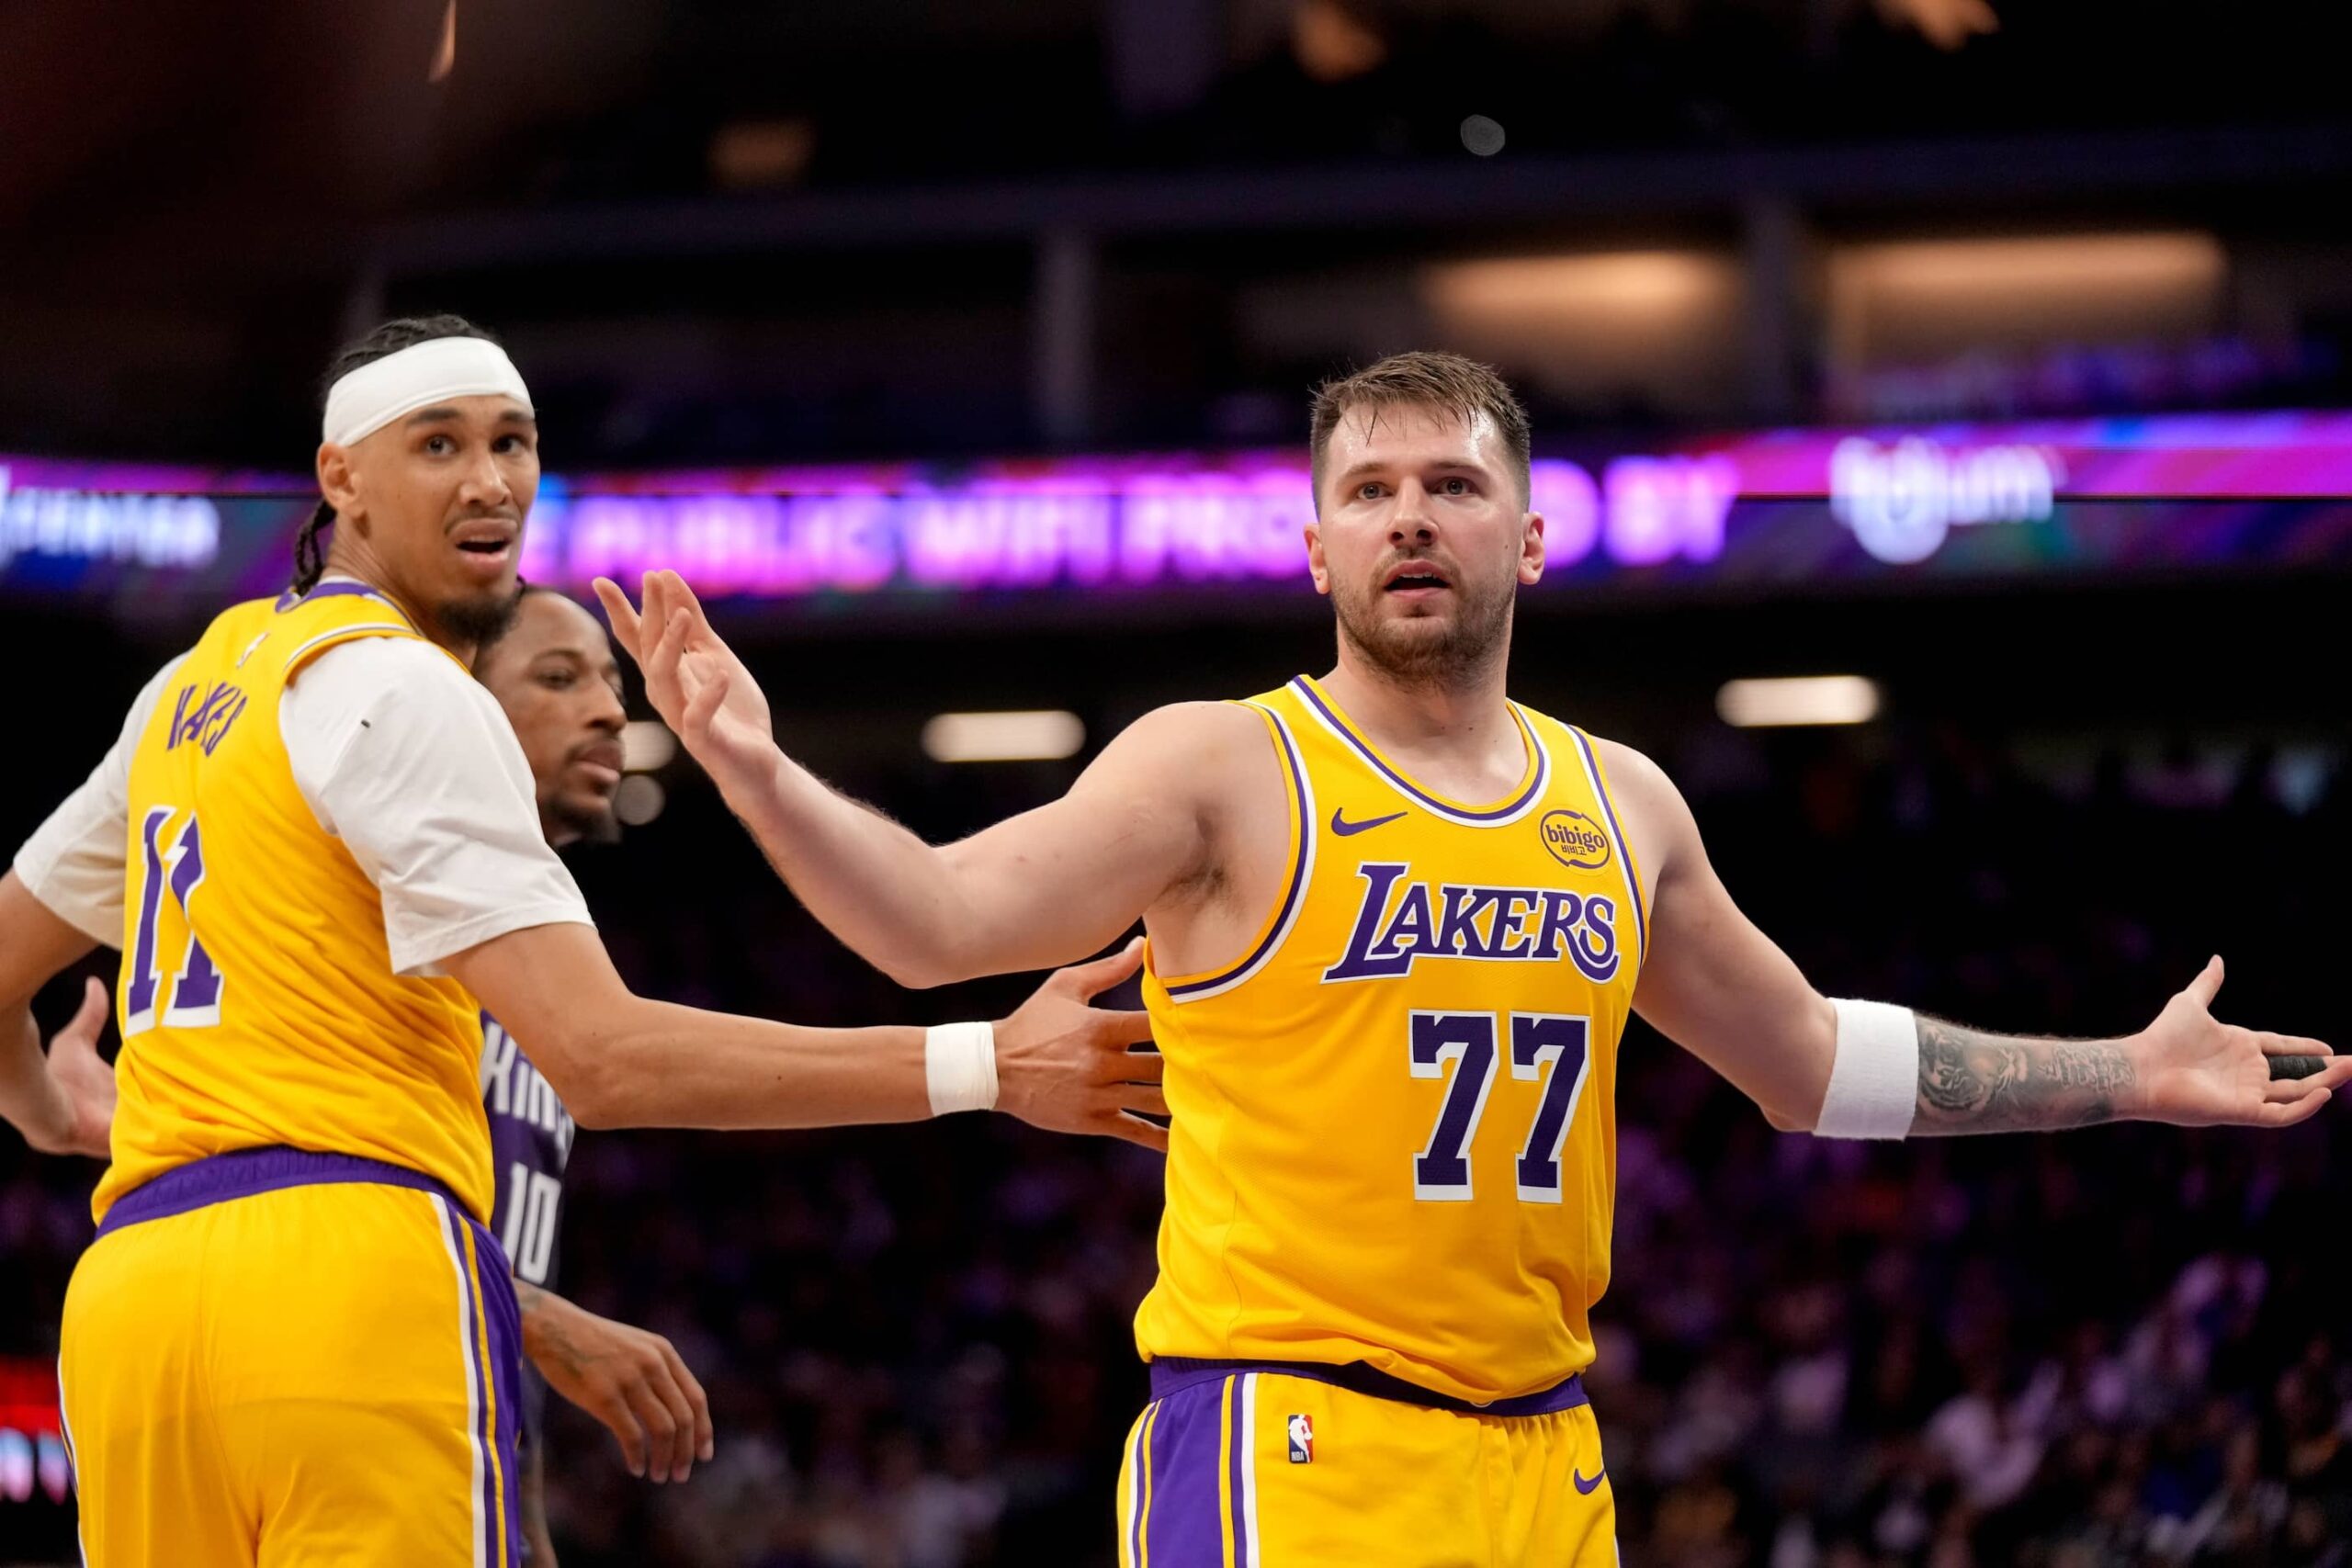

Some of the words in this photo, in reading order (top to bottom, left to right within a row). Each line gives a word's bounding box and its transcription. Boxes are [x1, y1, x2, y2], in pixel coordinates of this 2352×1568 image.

[1545, 824, 1605, 853] bibigo
[125, 805, 224, 1039] 11
[1319, 862, 1621, 985] LAKERS
[1408, 1009, 1591, 1204] 77
[502, 1161, 562, 1284] 10
[1291, 1451, 1305, 1461] NBA
